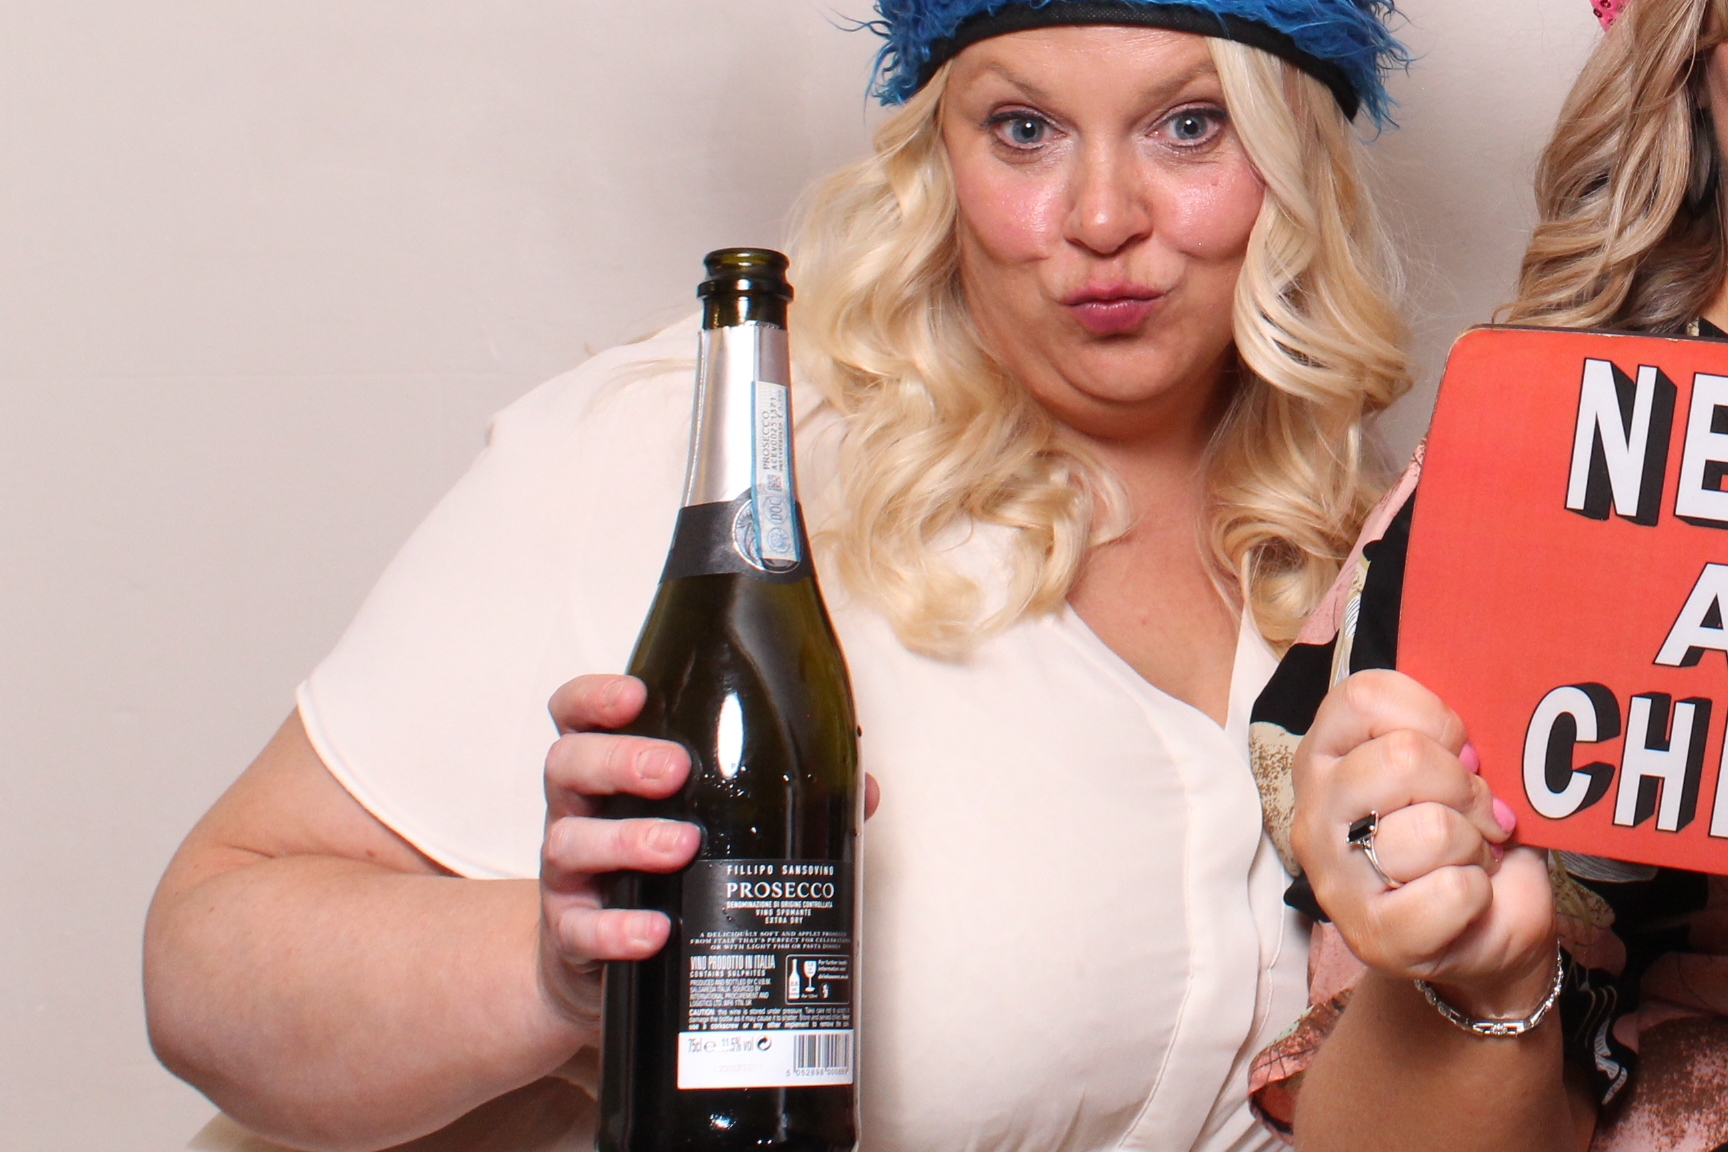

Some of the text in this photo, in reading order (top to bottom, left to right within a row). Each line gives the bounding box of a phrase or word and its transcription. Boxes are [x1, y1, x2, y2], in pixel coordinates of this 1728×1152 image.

[762, 410, 770, 470] PROSECCO
[769, 498, 783, 521] DOC
[727, 865, 834, 876] FILLIPO SANSOVINO
[726, 881, 835, 899] PROSECCO
[726, 900, 772, 909] DENOMINAZIONE
[773, 900, 780, 908] DI
[781, 900, 802, 908] ORIGINE
[776, 909, 812, 917] SPUMANTE
[690, 954, 775, 970] VINO PRODOTTO IN ITALIA
[690, 969, 766, 978] CONTAINS SULPHITES
[743, 1036, 754, 1052] vol
